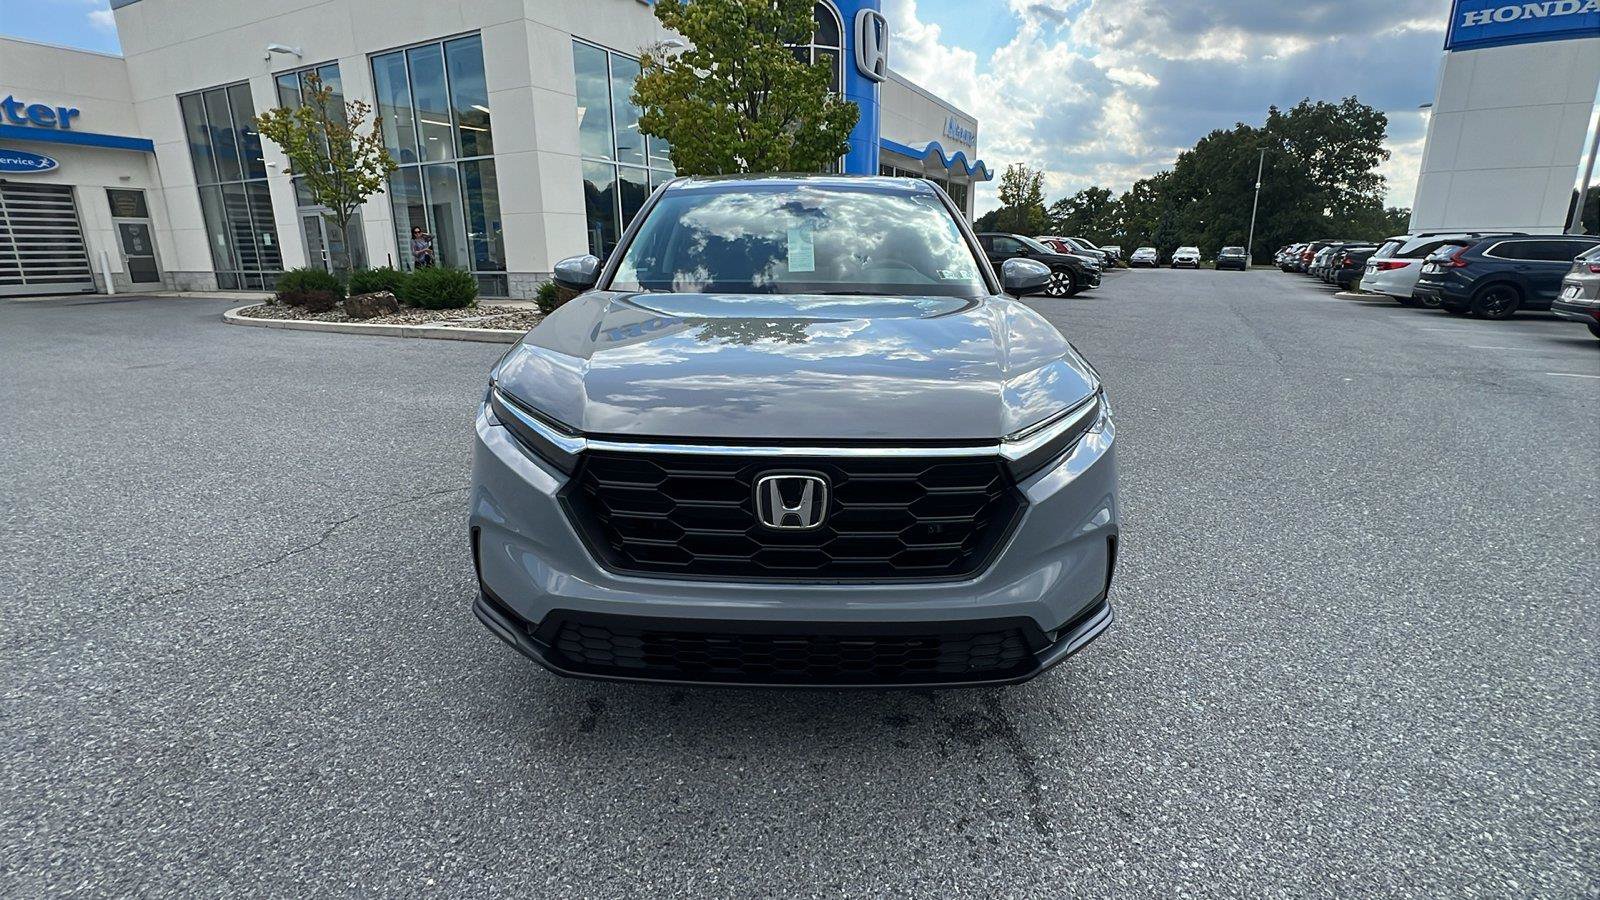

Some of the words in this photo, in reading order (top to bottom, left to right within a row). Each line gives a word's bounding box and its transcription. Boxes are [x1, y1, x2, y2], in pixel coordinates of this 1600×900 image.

[1461, 0, 1600, 27] HONDA
[0, 95, 80, 129] ter
[0, 157, 35, 166] ervice
